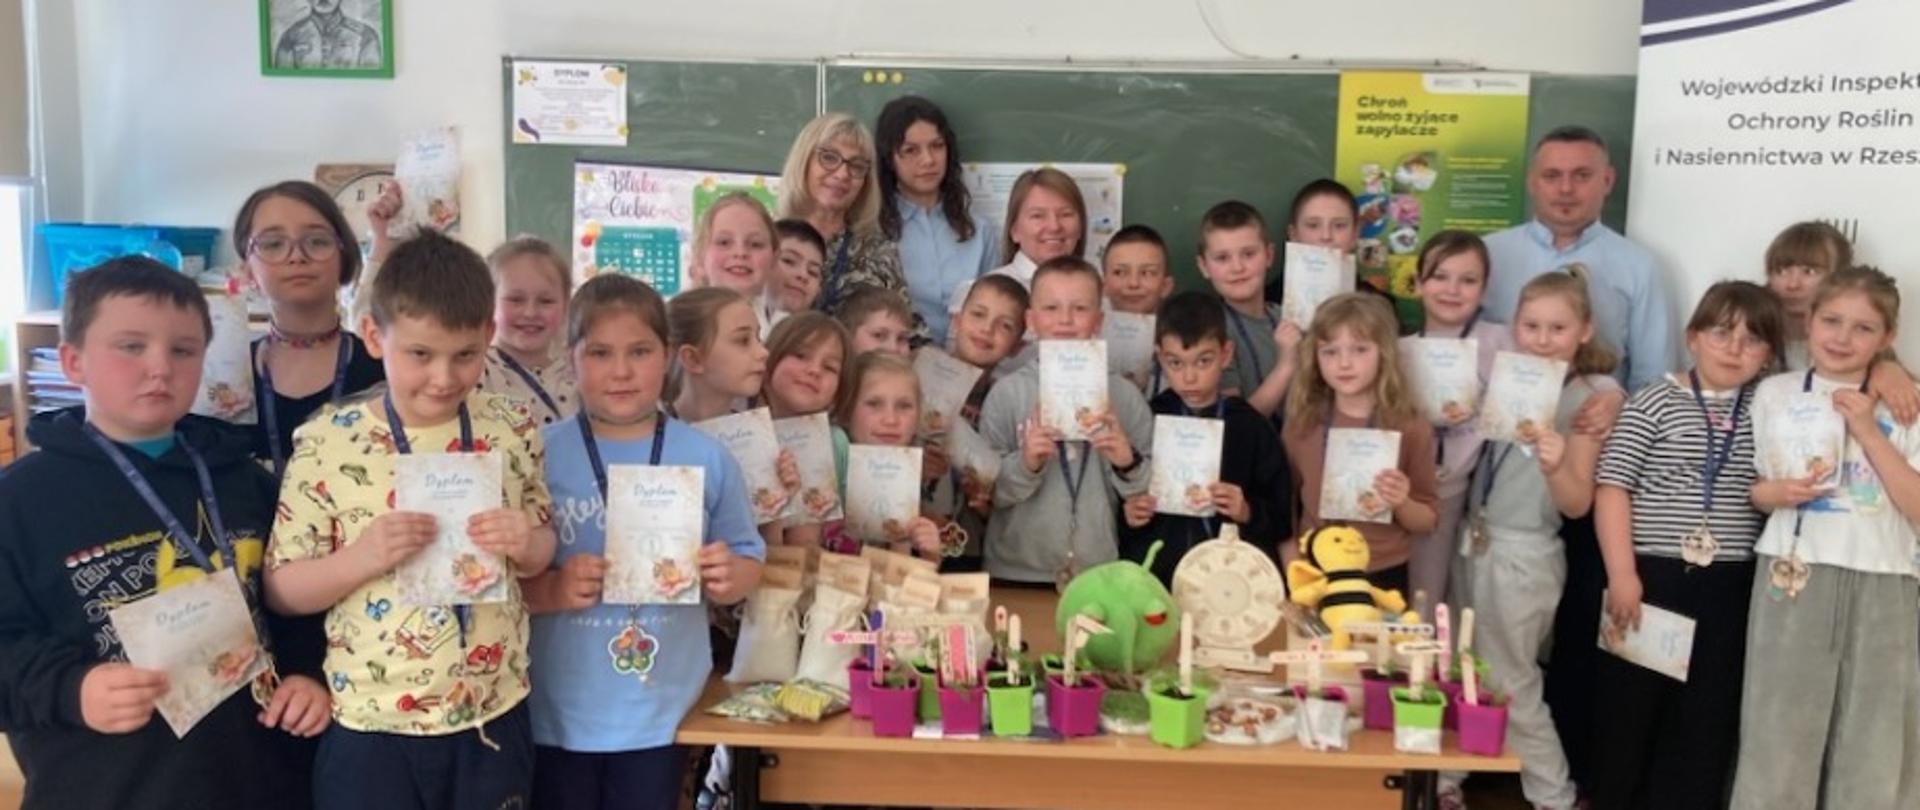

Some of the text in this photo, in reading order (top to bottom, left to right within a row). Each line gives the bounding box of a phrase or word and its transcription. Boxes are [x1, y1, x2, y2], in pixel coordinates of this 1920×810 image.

[1681, 75, 1823, 99] Wojewódzki
[1357, 110, 1402, 122] wolno
[1728, 109, 1913, 133] Ochrony Roślin
[1356, 124, 1439, 138] zapylacze
[1655, 147, 1920, 165] i Nasiennictwa w Rzes
[425, 473, 474, 488] Dyplom
